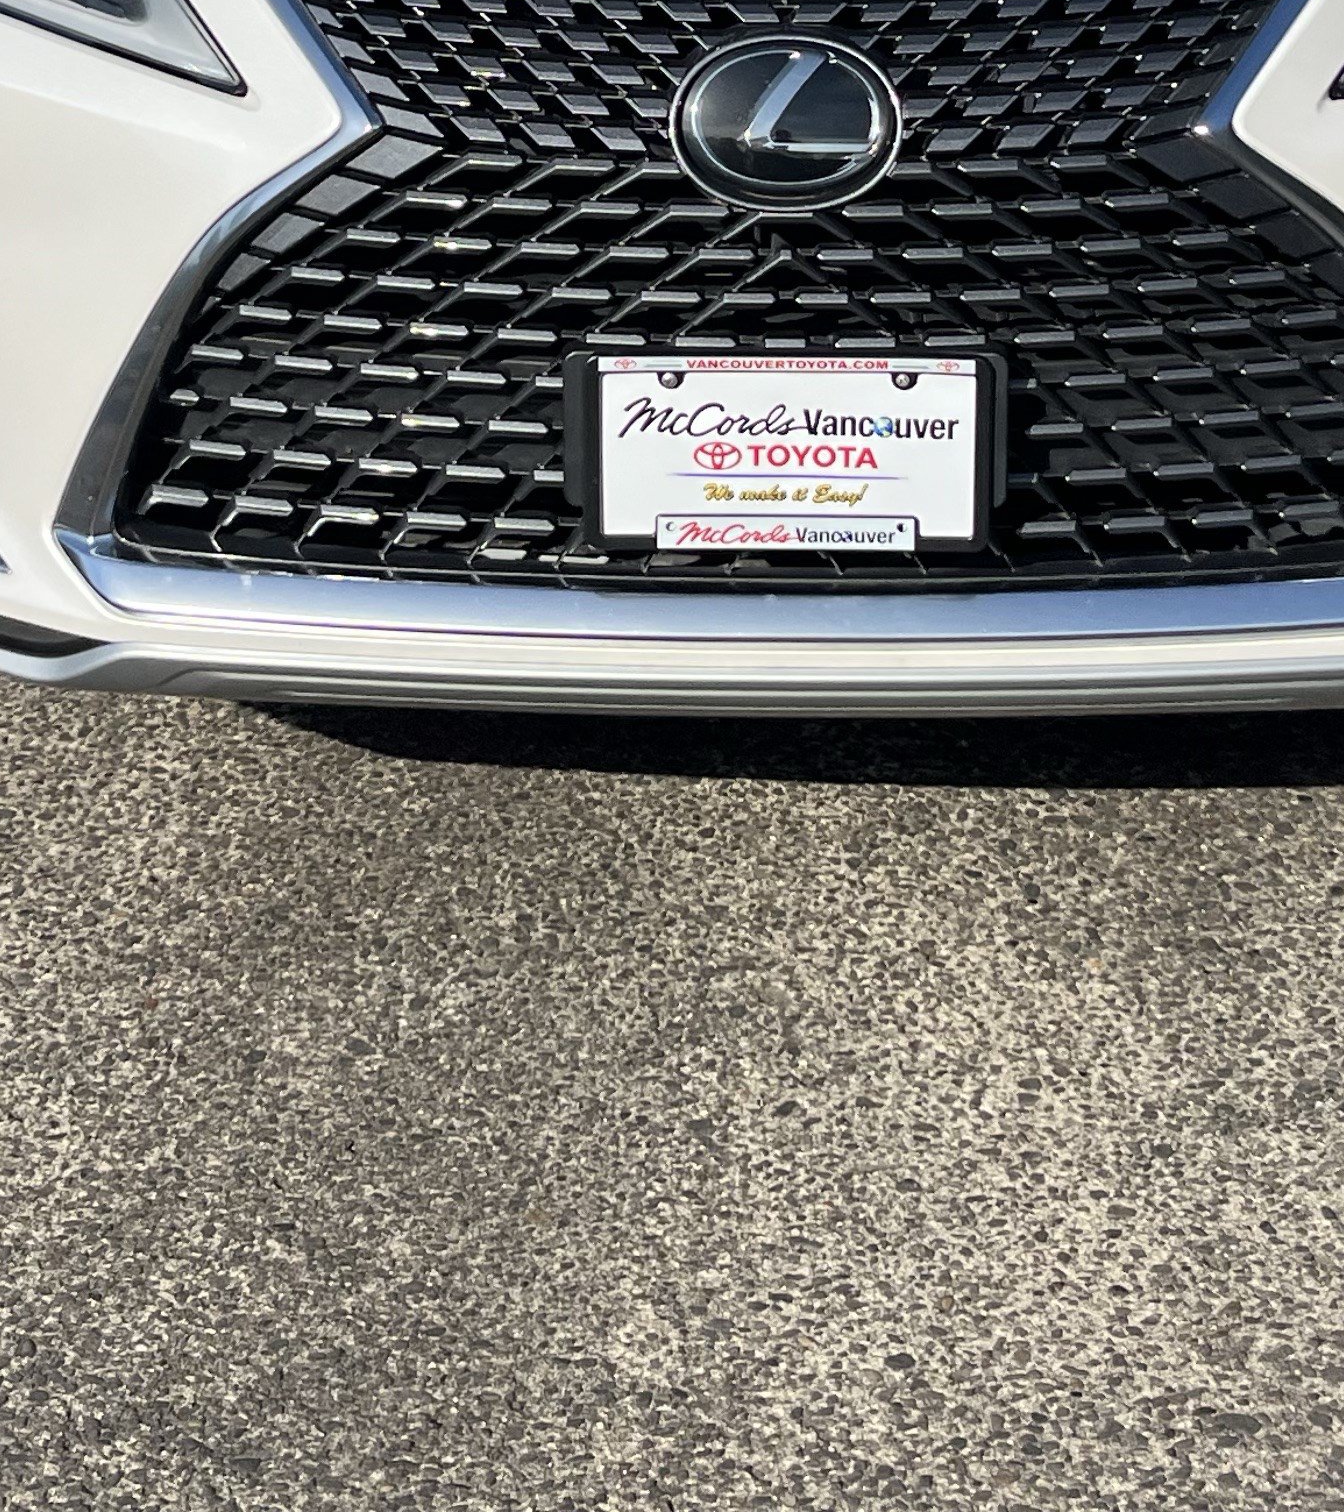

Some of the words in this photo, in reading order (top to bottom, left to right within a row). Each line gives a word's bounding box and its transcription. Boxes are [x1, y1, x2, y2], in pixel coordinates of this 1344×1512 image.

[686, 359, 889, 370] VANCOUVERTOYOTA.COM
[747, 444, 878, 469] TOYOTA
[703, 482, 734, 501] We
[739, 483, 787, 501] make
[792, 487, 808, 502] it
[812, 483, 869, 507] Easy!
